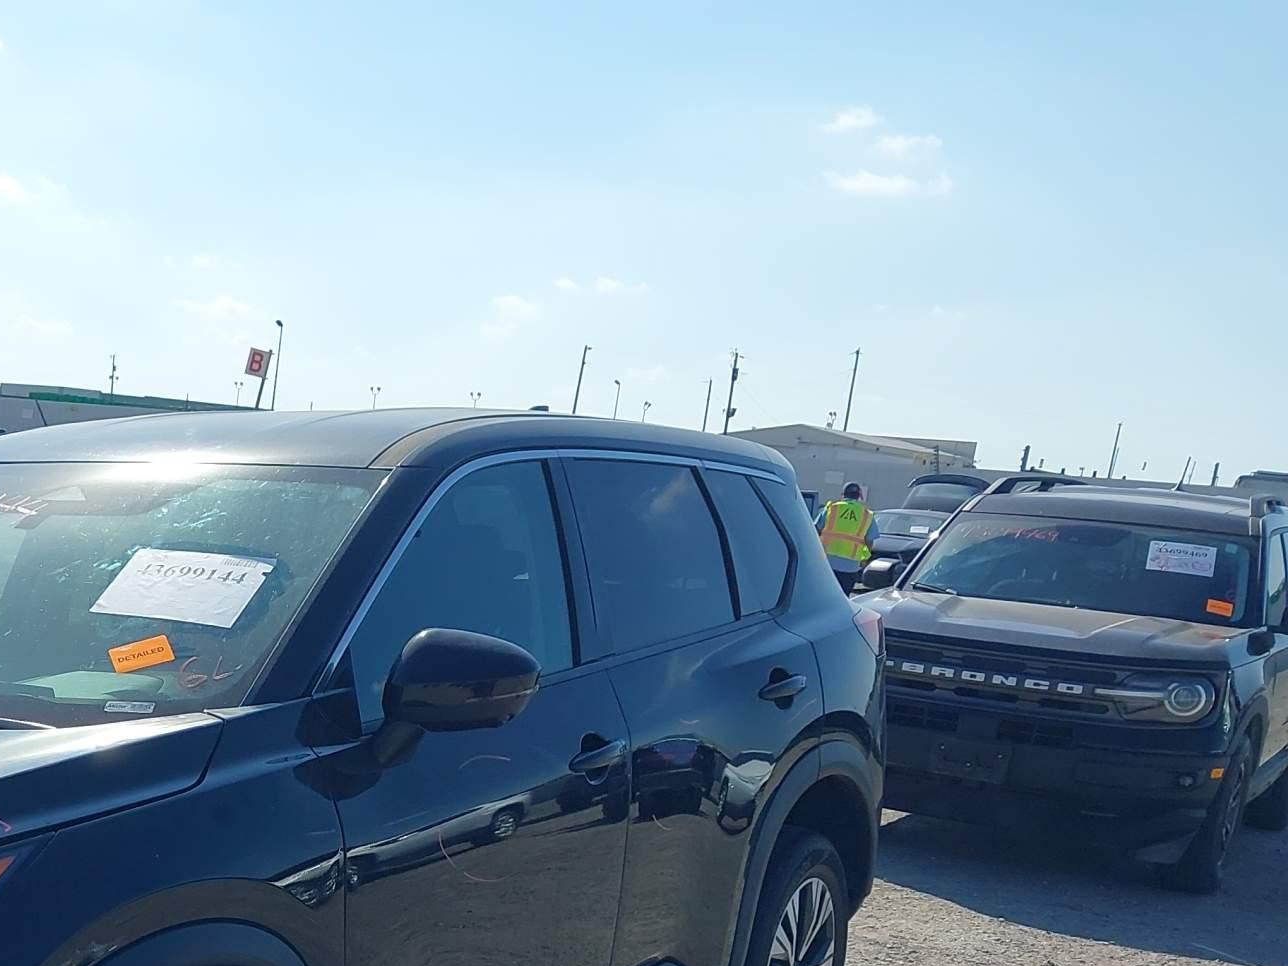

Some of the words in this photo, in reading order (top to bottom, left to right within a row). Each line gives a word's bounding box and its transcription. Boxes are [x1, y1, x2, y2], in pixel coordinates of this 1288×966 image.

[249, 352, 264, 372] B
[137, 563, 248, 585] 43699144
[117, 646, 165, 663] DETAILED
[902, 662, 1083, 694] BRONCO
